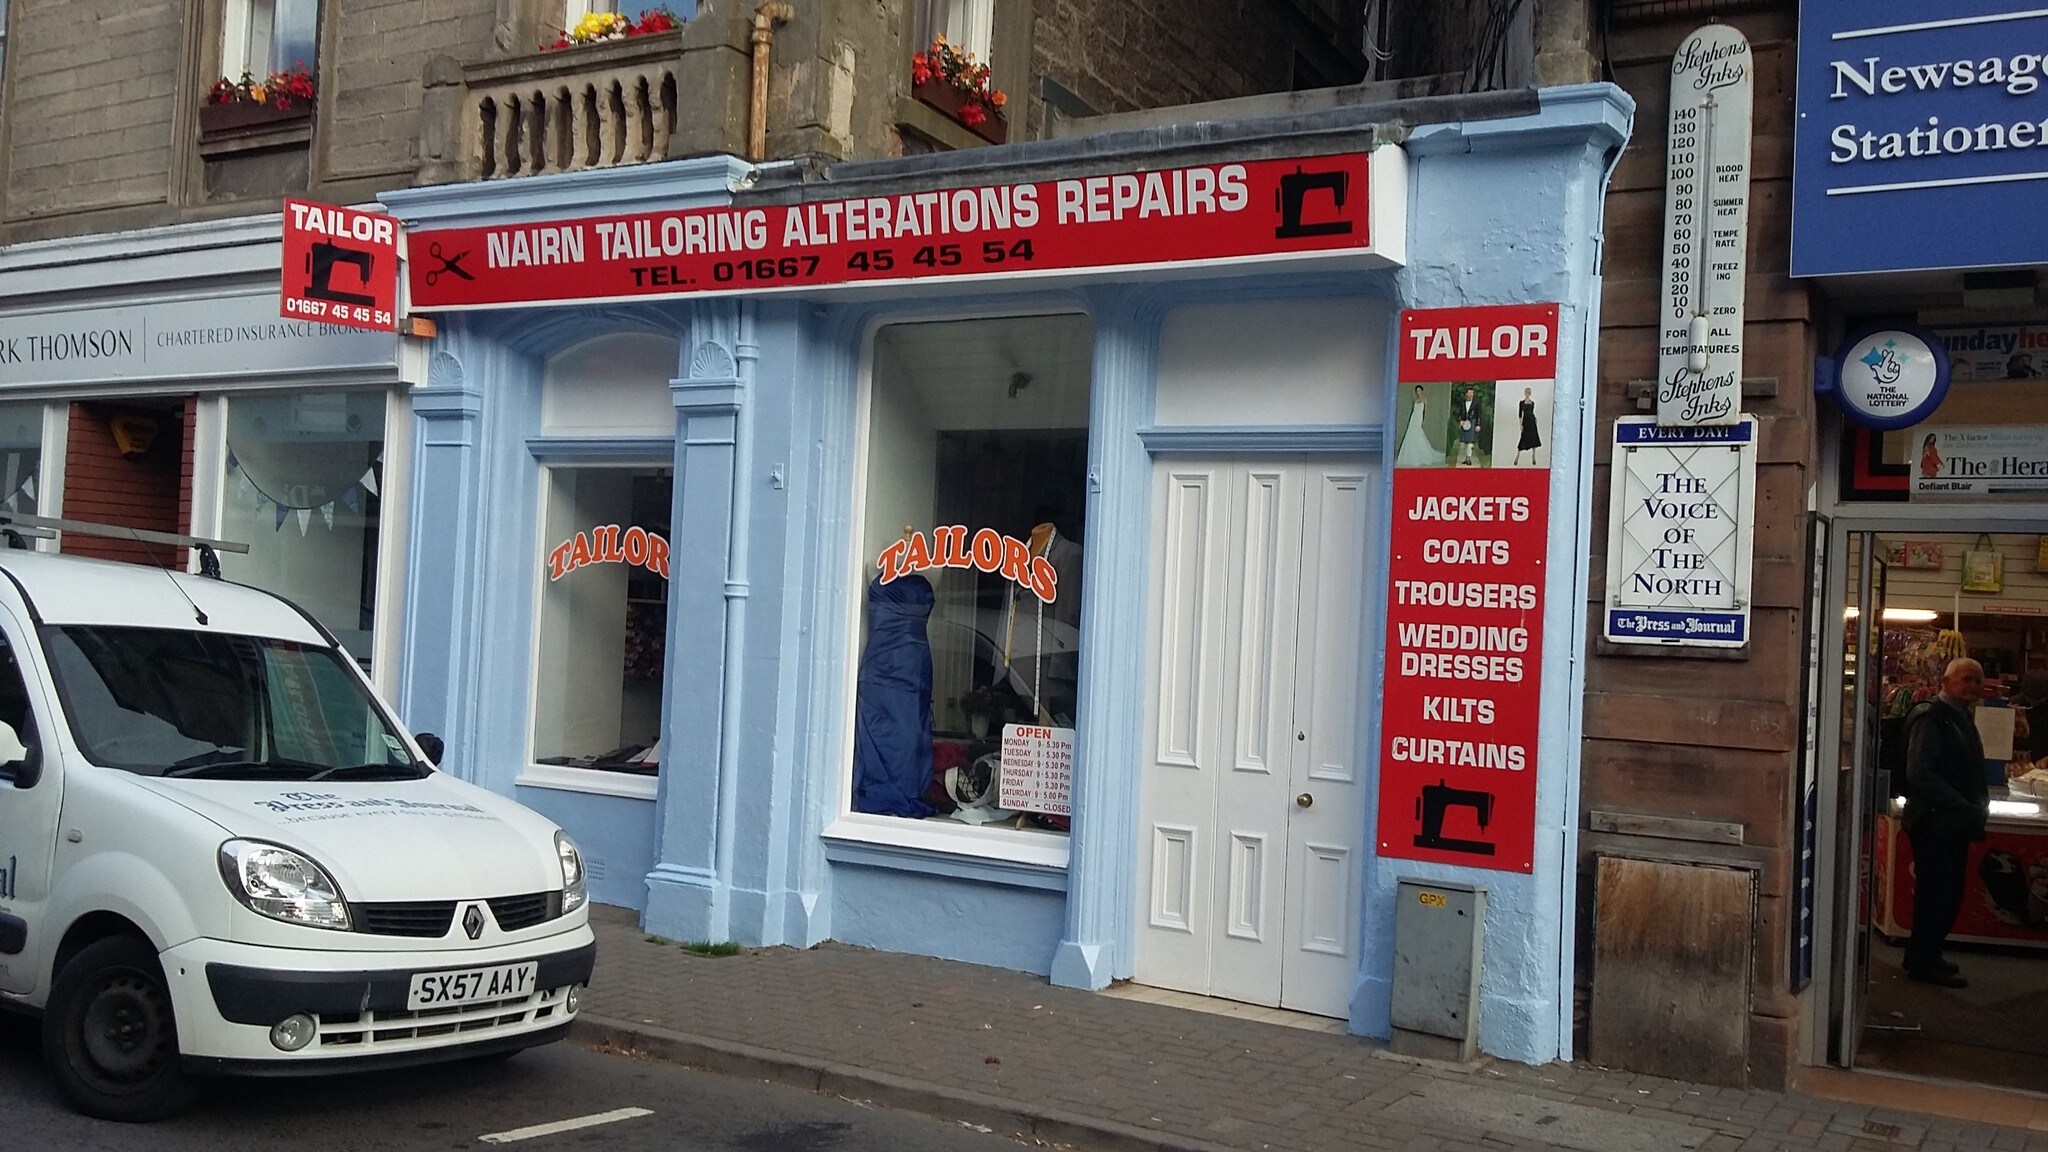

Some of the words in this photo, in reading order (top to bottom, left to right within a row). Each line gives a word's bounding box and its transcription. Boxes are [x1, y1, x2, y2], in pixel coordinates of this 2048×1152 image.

[1693, 61, 1743, 92] Inks
[1674, 108, 1696, 120] 140
[1673, 122, 1696, 134] 130
[1672, 137, 1695, 149] 120
[1671, 152, 1694, 165] 110
[1671, 168, 1694, 180] 100
[1716, 164, 1743, 173] BLOOD
[1719, 174, 1739, 183] HEAT
[1676, 184, 1693, 195] 90
[1675, 199, 1692, 210] 80
[1713, 198, 1744, 207] SUMMER
[486, 225, 584, 268] NAIRN
[600, 210, 767, 260] TAILORING
[783, 184, 1040, 247] ALTERATIONS
[1056, 164, 1249, 225] REPAIRS
[1717, 208, 1738, 216] HEAT
[290, 203, 393, 245] TAILOR
[1674, 214, 1692, 225] 70
[1674, 229, 1691, 240] 60
[1713, 230, 1739, 238] TEMPE
[1672, 243, 1690, 255] 50
[629, 267, 696, 288] TEL.
[713, 255, 821, 282] 01667
[847, 249, 894, 272] 45
[913, 243, 962, 268] 45
[982, 239, 1035, 263] 54
[1671, 258, 1689, 268] 40
[1712, 262, 1739, 271] FREEZ
[1671, 272, 1689, 283] 30
[1671, 284, 1689, 295] 20
[1672, 297, 1688, 307] 10
[286, 298, 327, 316] 01667
[332, 304, 348, 319] 45
[353, 307, 370, 321] 45
[375, 311, 391, 325] 54
[1675, 308, 1684, 318] 0
[1713, 307, 1736, 315] ZERO
[157, 326, 233, 347] CHARTERED
[237, 322, 314, 342] INSURANCE
[1666, 329, 1687, 339] FOR
[1710, 328, 1731, 337] ALL
[27, 329, 132, 362] THOMSON
[1410, 324, 1548, 361] TAILOR
[1661, 345, 1740, 356] TEMPRATURES
[1681, 393, 1731, 424] Inks
[1638, 427, 1687, 439] EVERY
[1946, 457, 1987, 476] The
[1919, 482, 1949, 491] Defiant
[1408, 496, 1529, 522] JACKETS
[1423, 539, 1510, 565] COATS
[877, 525, 1057, 604] TAILORS
[1395, 580, 1537, 610] TROUSERS
[1617, 618, 1635, 628] The
[1635, 615, 1670, 633] Press
[1671, 620, 1686, 631] and
[1685, 617, 1736, 634] Journal
[1398, 622, 1528, 653] WEDDING
[1401, 652, 1523, 682] DRESSES
[1423, 696, 1495, 724] KILTS
[1016, 727, 1051, 739] OPEN
[1004, 738, 1030, 747] MONDAY
[1004, 748, 1031, 756] TUESDAY
[1391, 737, 1525, 771] CURTAINS
[1003, 759, 1033, 767] WEDNESDAY
[1003, 768, 1033, 777] THURSDAY
[1002, 778, 1024, 787] FRIDAY
[1002, 788, 1031, 797] SATURDAY
[1002, 798, 1029, 808] SUNDAY
[1044, 803, 1071, 813] CLOSED
[1419, 893, 1446, 906] GPX
[420, 972, 483, 1003] SX57
[487, 966, 529, 996] AAY
